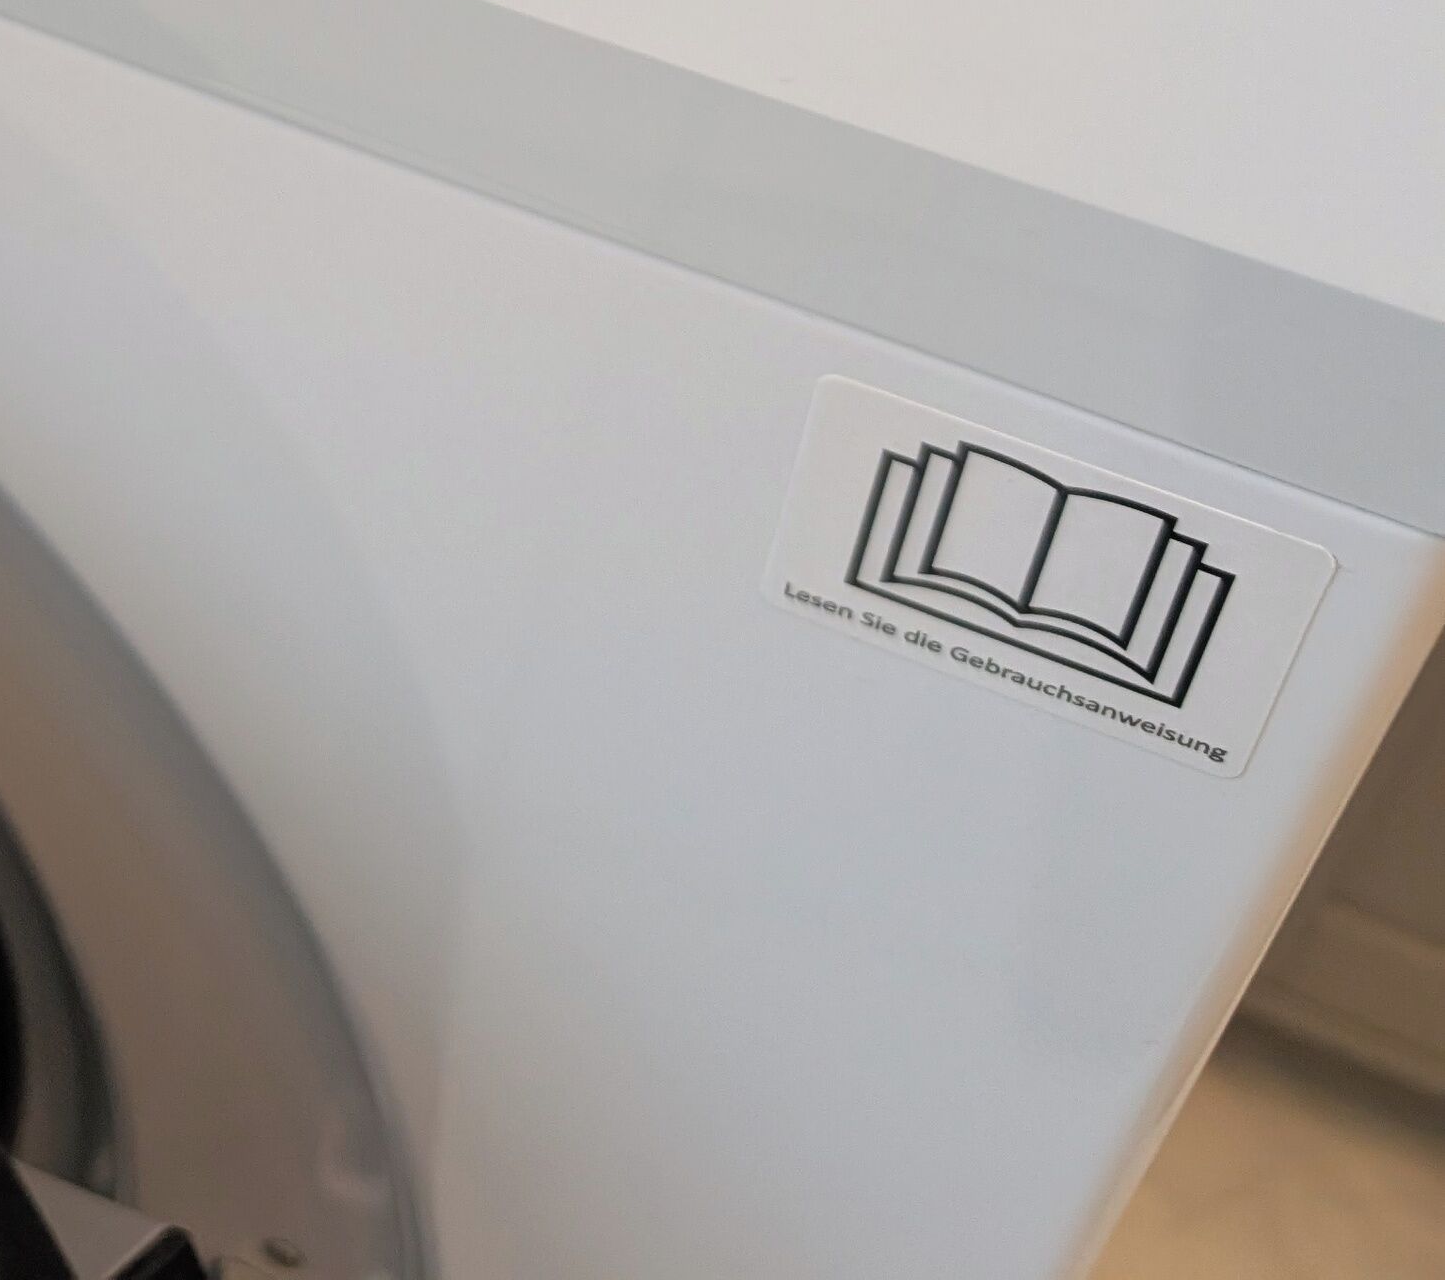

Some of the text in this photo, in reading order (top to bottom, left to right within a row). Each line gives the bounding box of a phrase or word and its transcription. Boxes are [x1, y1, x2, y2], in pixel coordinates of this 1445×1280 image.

[783, 581, 1229, 765] Lesen Sie die Gebrauchsanweisung
